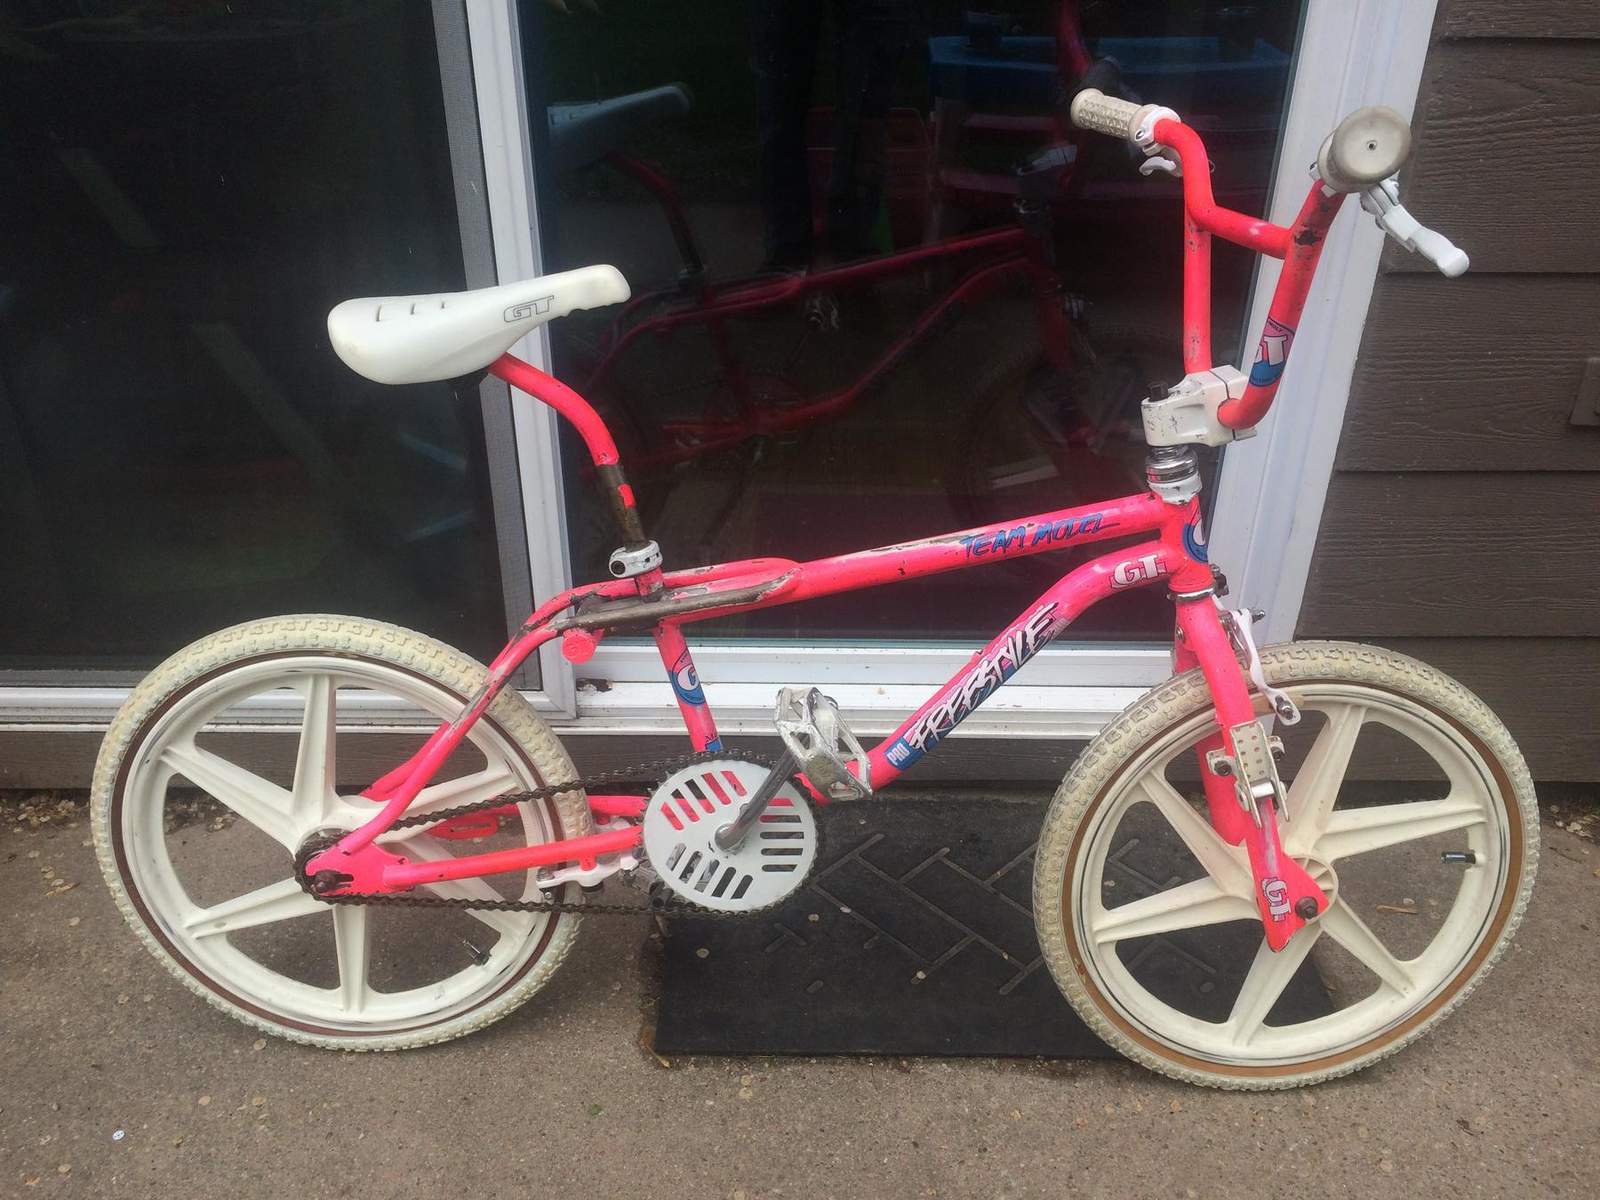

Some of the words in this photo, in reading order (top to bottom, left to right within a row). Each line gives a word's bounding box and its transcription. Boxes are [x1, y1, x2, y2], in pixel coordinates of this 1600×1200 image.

[503, 295, 555, 322] GT
[960, 526, 1025, 558] TEAM
[1110, 554, 1162, 587] GT
[886, 742, 910, 766] PRO
[908, 601, 1060, 753] FREESTYLE
[1263, 878, 1291, 919] GT
